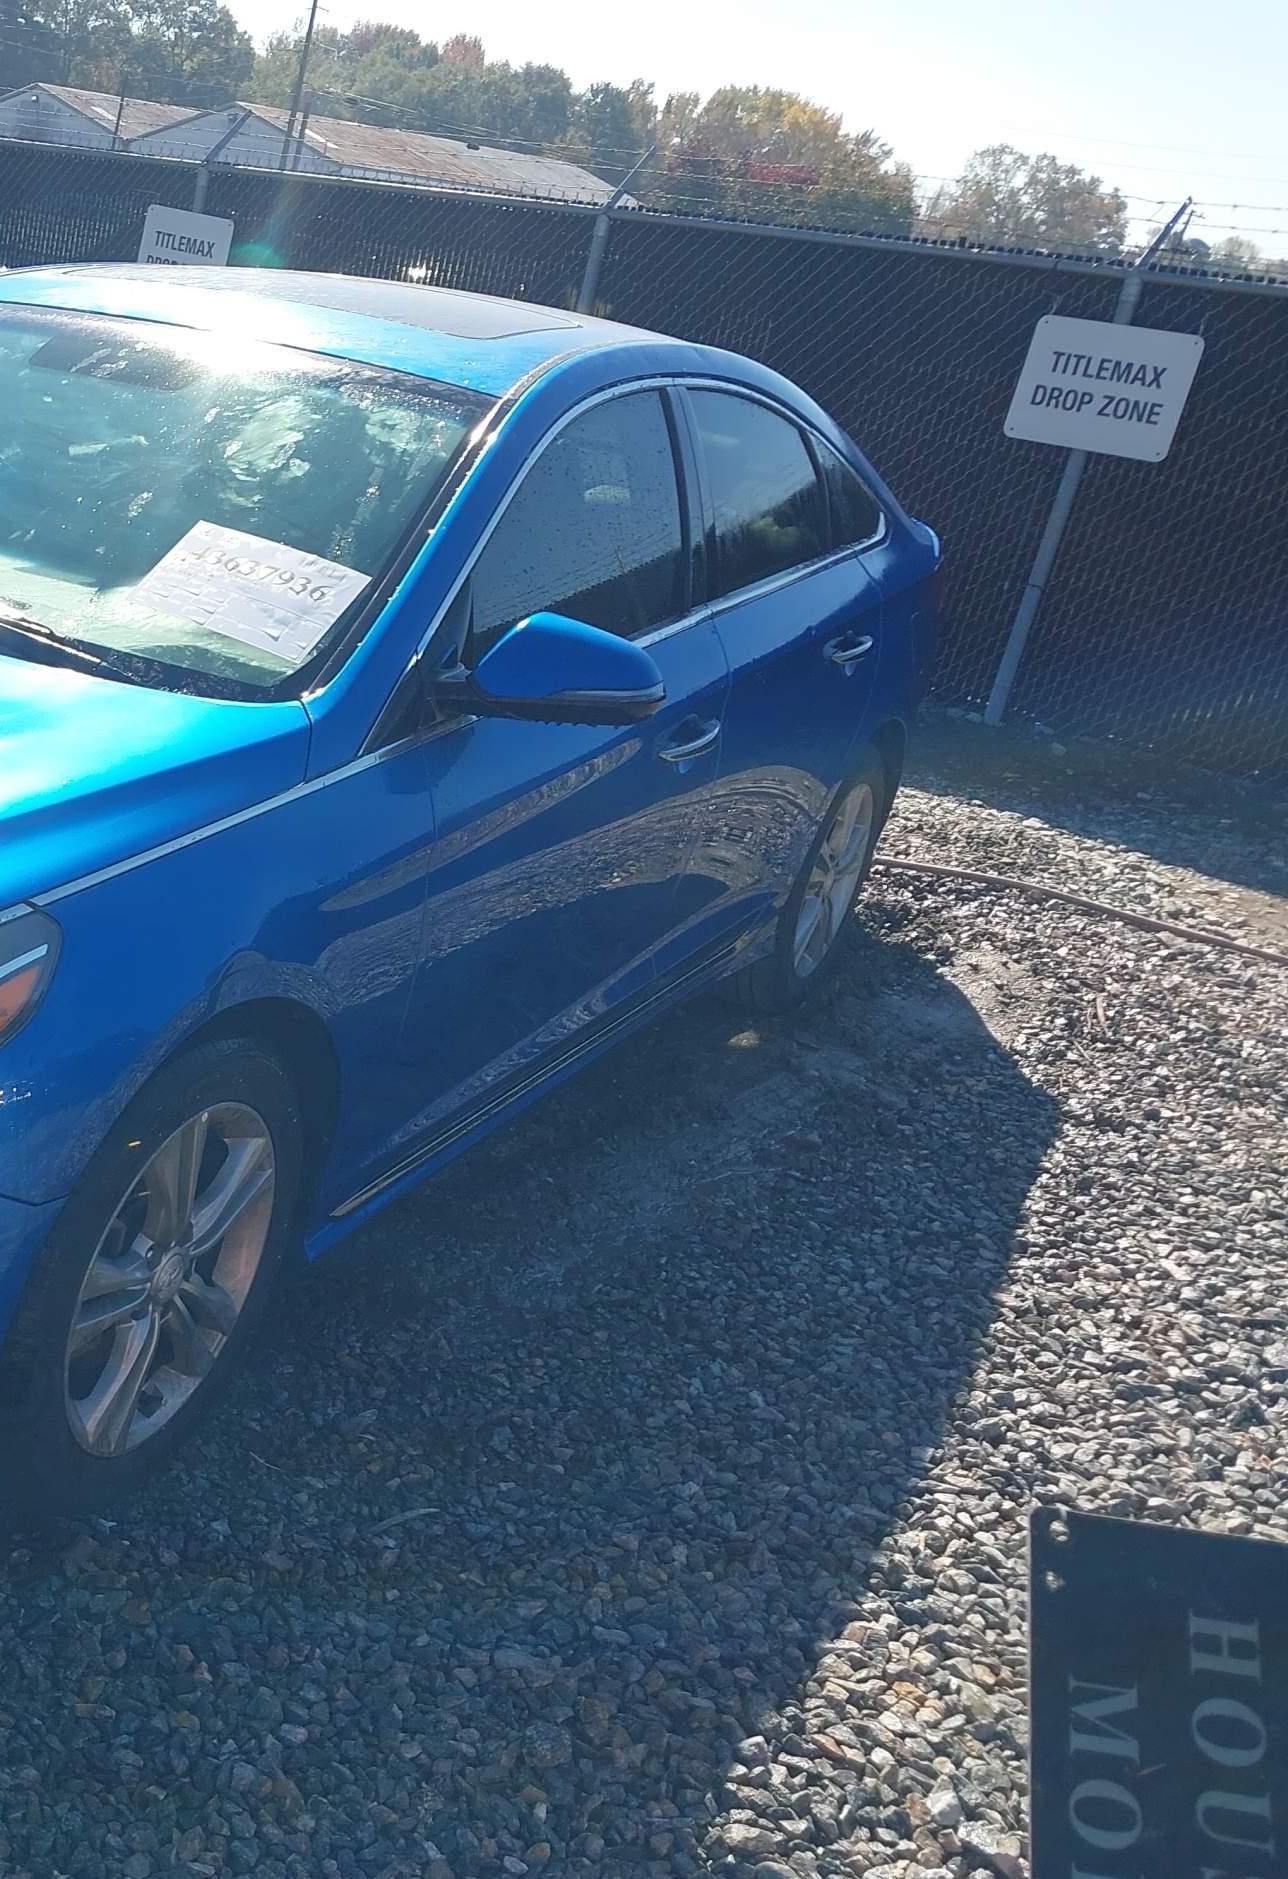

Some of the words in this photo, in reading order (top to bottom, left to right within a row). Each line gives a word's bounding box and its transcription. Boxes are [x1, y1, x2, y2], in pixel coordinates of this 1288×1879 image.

[155, 230, 216, 258] TITLEMAX
[1051, 351, 1168, 389] TITLEMAX
[1030, 384, 1094, 413] DROP
[1097, 395, 1164, 425] ZONE
[1187, 1608, 1275, 1879] HOU
[1068, 1673, 1144, 1879] MO
